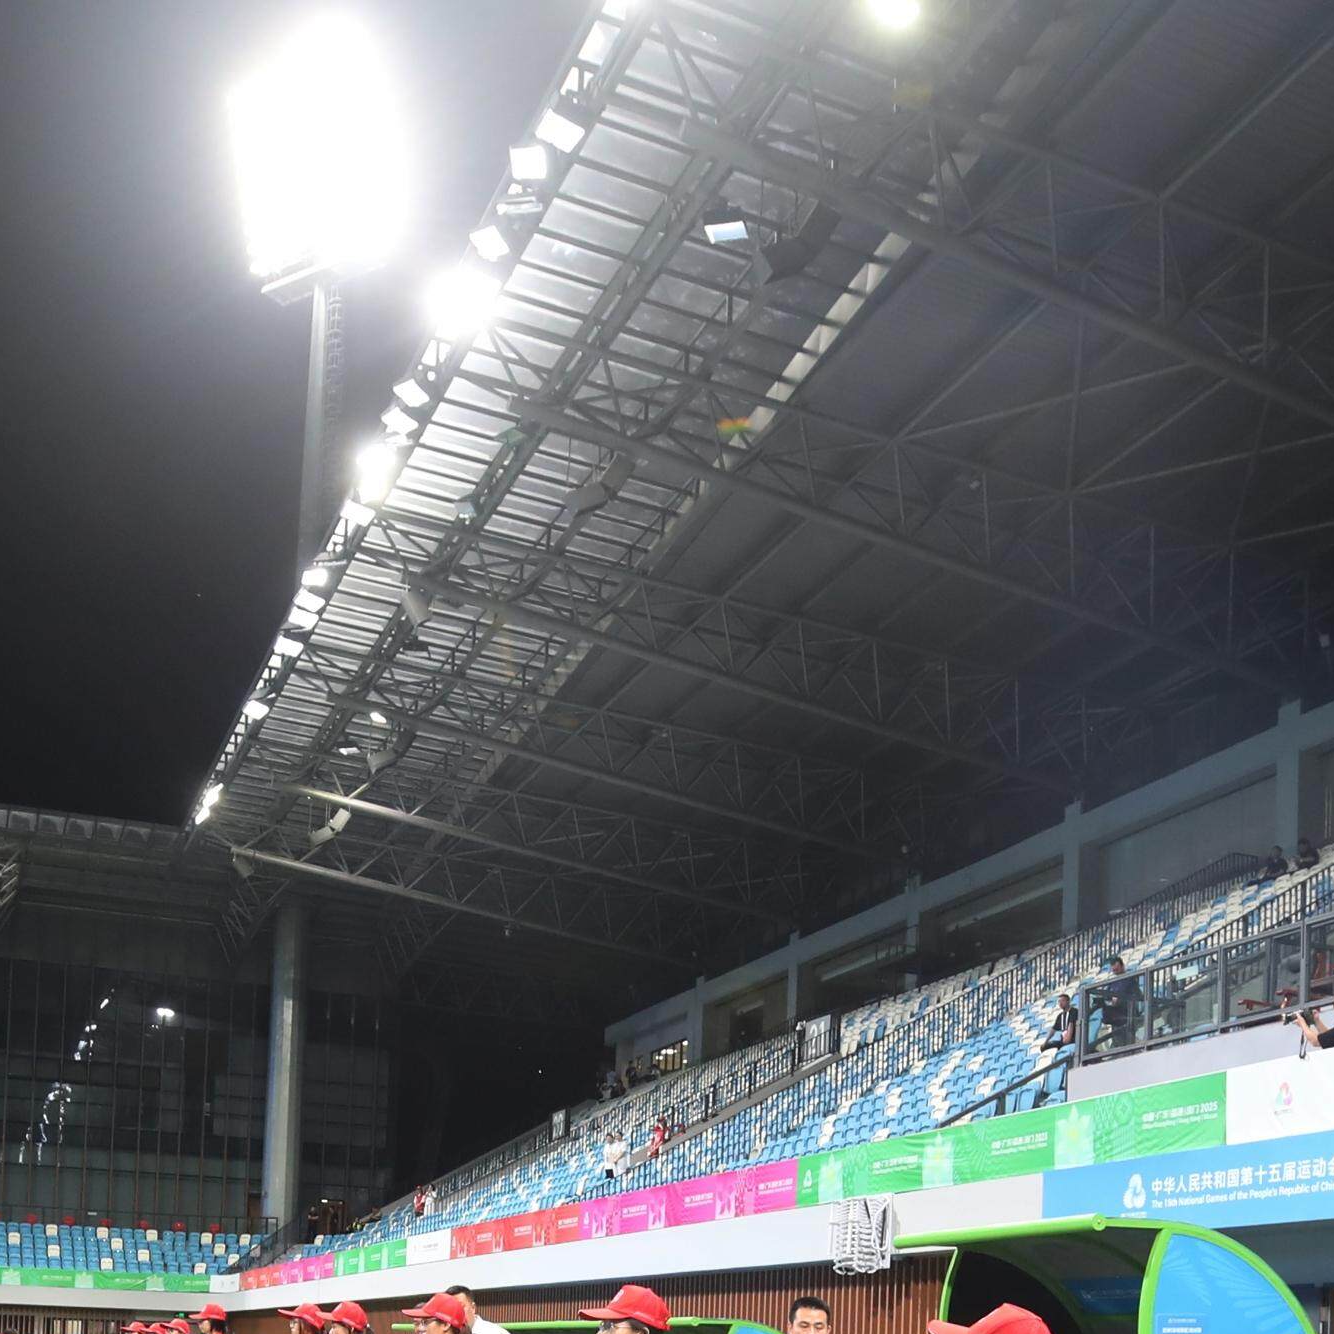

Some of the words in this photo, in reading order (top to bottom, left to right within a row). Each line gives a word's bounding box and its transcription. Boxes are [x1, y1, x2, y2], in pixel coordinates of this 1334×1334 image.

[1152, 1199, 1163, 1208] The
[1178, 1195, 1205, 1207] National
[1205, 1193, 1228, 1204] Games
[1228, 1191, 1237, 1201] of
[1237, 1190, 1248, 1199] the
[1249, 1186, 1278, 1200] People's
[1278, 1184, 1311, 1198] Republic
[1311, 1182, 1320, 1193] of
